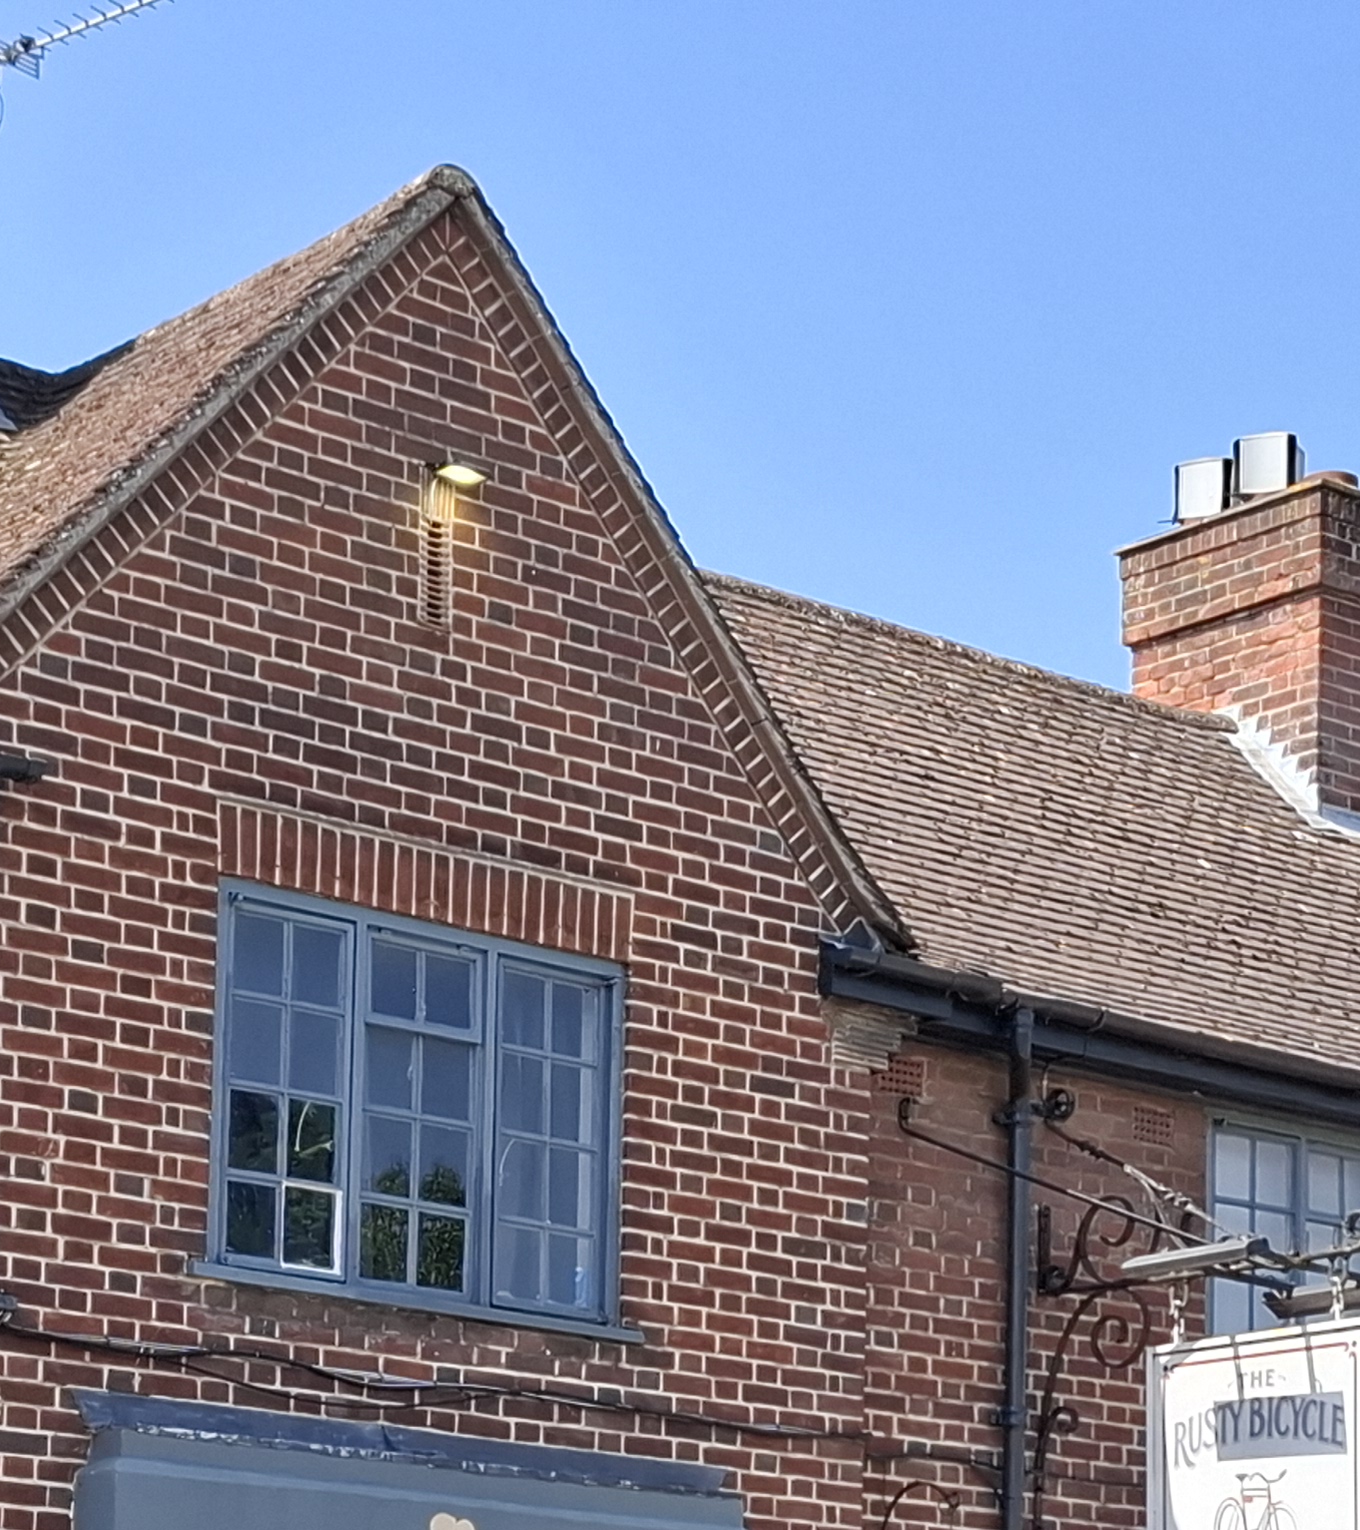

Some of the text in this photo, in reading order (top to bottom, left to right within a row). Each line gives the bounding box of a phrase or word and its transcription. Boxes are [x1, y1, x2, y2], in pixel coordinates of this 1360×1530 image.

[1239, 1368, 1276, 1389] THE
[1173, 1394, 1346, 1470] RUSTY BICYCLE
